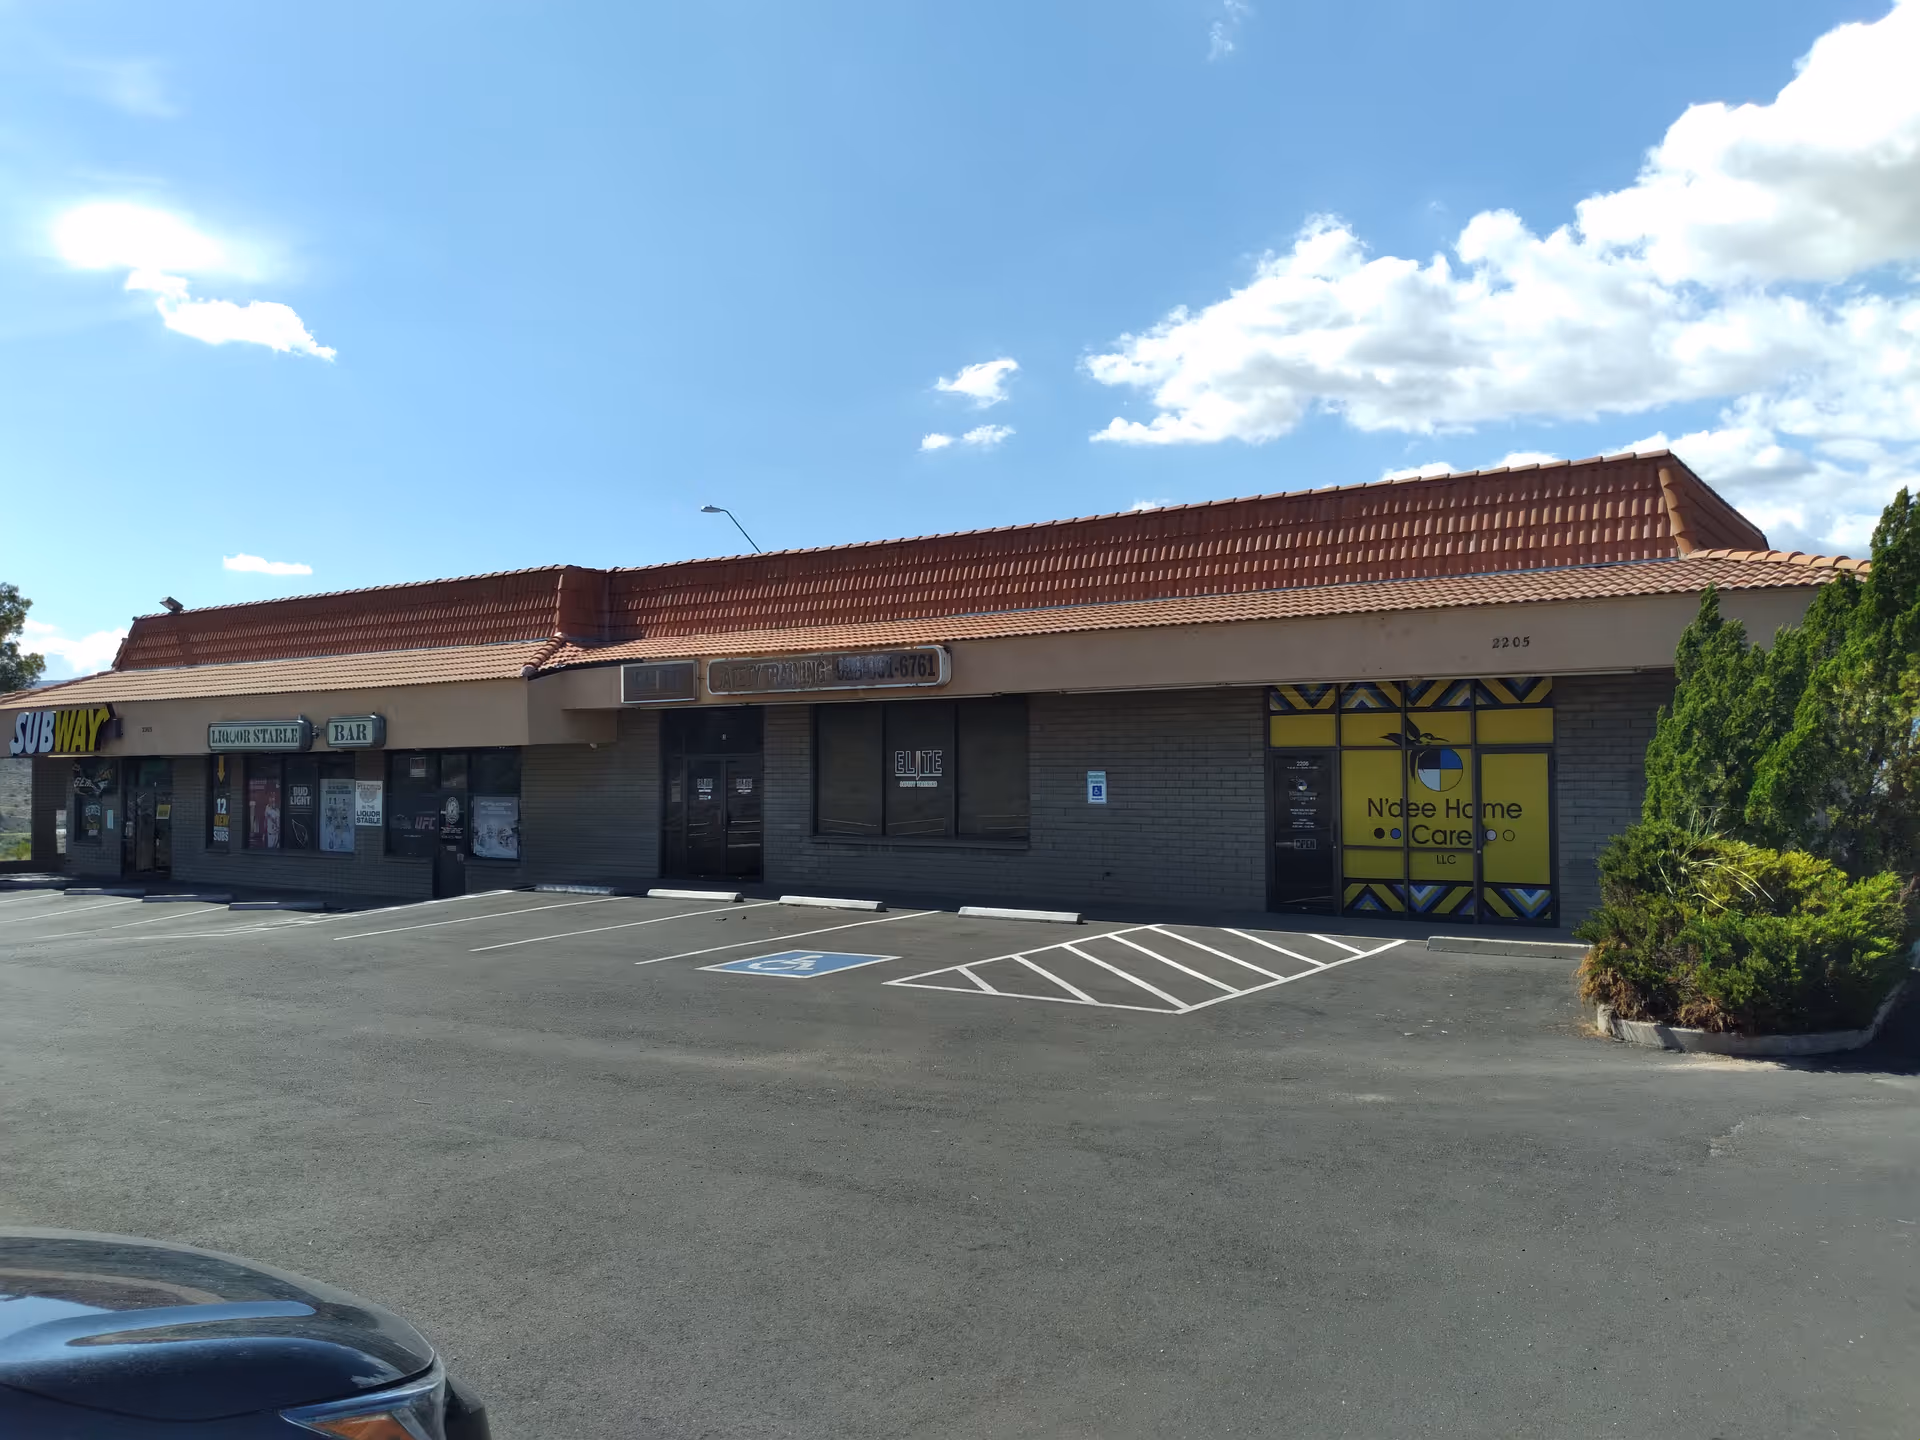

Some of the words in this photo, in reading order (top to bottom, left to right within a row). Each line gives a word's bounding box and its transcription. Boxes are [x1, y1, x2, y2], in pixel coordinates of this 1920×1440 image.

[1492, 636, 1530, 649] 2205
[9, 706, 110, 756] SUBWAY
[211, 728, 250, 745] LIQUOR
[253, 727, 298, 744] STABLE
[333, 723, 367, 742] BAR
[894, 750, 943, 780] ELITE
[293, 786, 308, 796] BUD
[216, 798, 227, 814] 12
[290, 796, 311, 805] LIGHT
[356, 810, 381, 818] LIQUOR
[1368, 798, 1436, 818] N'dee
[1446, 798, 1523, 819] Home
[356, 817, 381, 825] STABLE
[415, 816, 436, 829] UFC
[213, 831, 229, 842] SUBS
[1411, 824, 1473, 845] Care
[1295, 839, 1316, 849] OPEN
[1436, 854, 1456, 865] LLC
